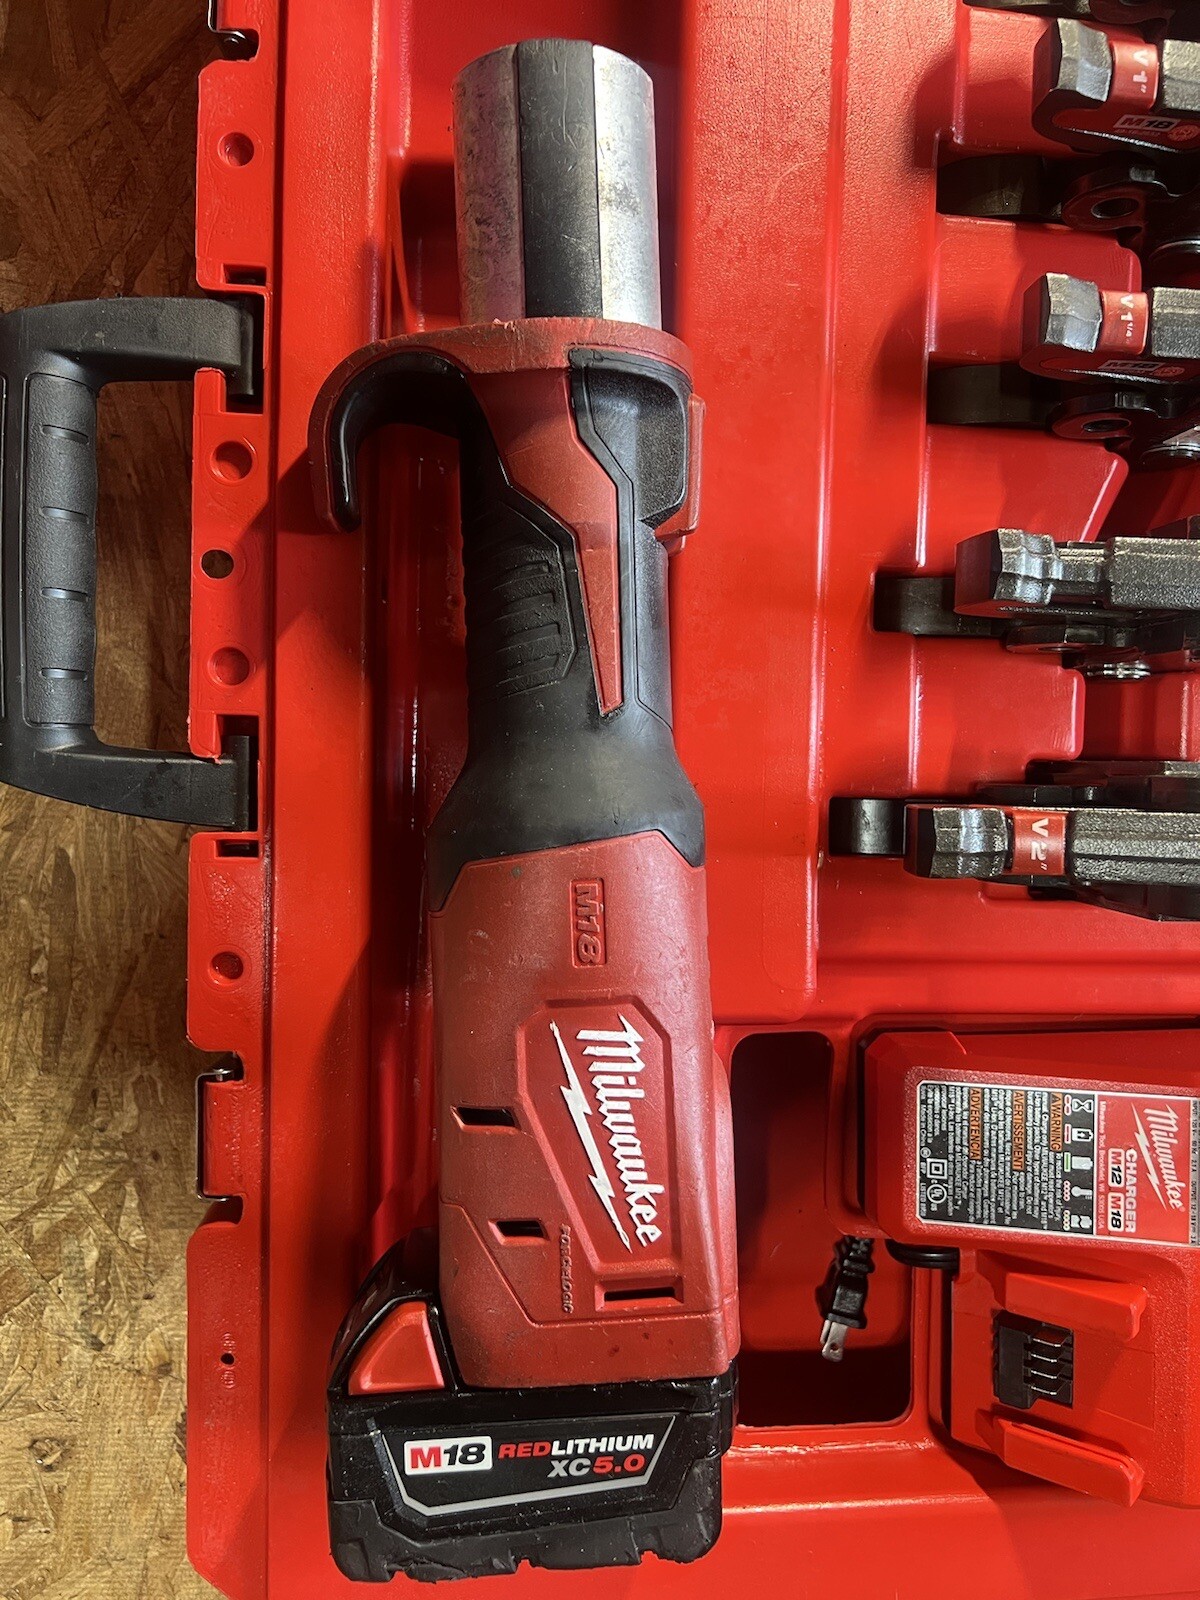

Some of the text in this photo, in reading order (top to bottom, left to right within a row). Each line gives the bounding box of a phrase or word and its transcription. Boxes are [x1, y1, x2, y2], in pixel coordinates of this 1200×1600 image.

[1031, 817, 1049, 838] V
[575, 883, 602, 965] M18
[575, 1013, 665, 1248] Milwaukee
[970, 1088, 980, 1158] ADVERTENCIA
[1013, 1091, 1023, 1169] AVERTISSEMENT
[1051, 1103, 1060, 1150] WARNING
[1098, 1100, 1107, 1133] Milwaukee
[1110, 1151, 1123, 1230] M12 M18
[1125, 1147, 1138, 1233] CHARGER
[1143, 1103, 1186, 1210] Milwaukee
[409, 1440, 486, 1471] M18
[498, 1433, 655, 1460] REDLITHIUM
[547, 1453, 646, 1479] XC5.0
